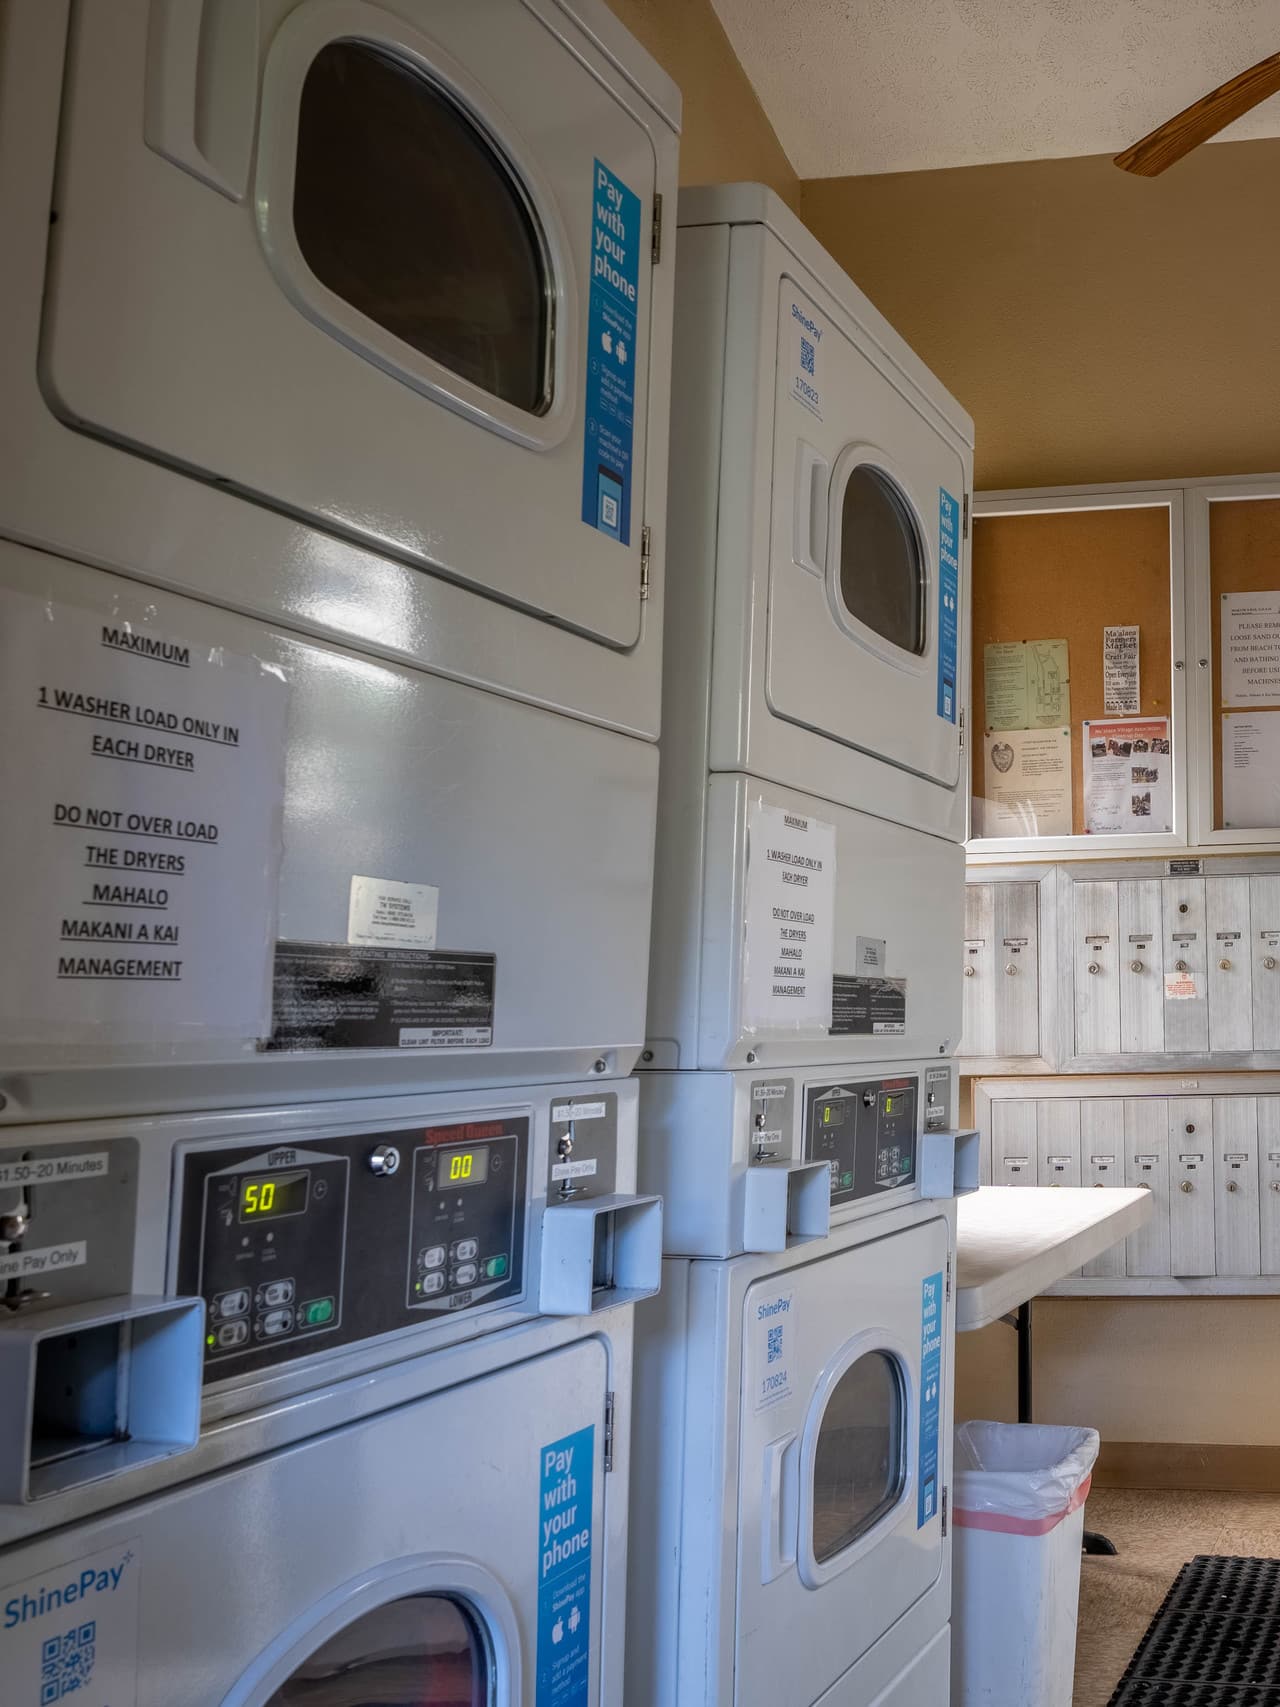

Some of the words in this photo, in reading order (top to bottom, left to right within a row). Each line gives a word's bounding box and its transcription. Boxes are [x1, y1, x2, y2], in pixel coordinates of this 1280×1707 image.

[598, 167, 623, 211] Pay
[597, 202, 625, 241] with
[595, 226, 625, 265] your
[594, 254, 635, 302] phone
[941, 492, 952, 516] Pay
[101, 626, 190, 667] MAXIMUM
[38, 686, 48, 705] 1
[53, 689, 130, 721] WASHER
[136, 705, 178, 730] LOAD
[182, 717, 220, 738] ONLY
[223, 726, 240, 744] IN
[91, 735, 138, 758] EACH
[143, 744, 194, 769] DRYER
[53, 804, 81, 824] DO
[85, 807, 123, 829] NOT
[127, 813, 172, 835] OVER
[176, 820, 218, 841] LOAD
[784, 815, 808, 831] MAXIMUM
[85, 846, 119, 865] THE
[123, 850, 185, 873] DRYERS
[771, 849, 791, 862] WASHER
[792, 854, 804, 866] LOAD
[806, 857, 816, 868] ONLY
[817, 861, 822, 869] IN
[782, 871, 792, 882] EACH
[793, 872, 808, 885] DRYER
[92, 884, 168, 906] MAHALO
[772, 907, 780, 917] DO
[780, 908, 789, 919] NOT
[790, 910, 802, 921] OVER
[803, 912, 815, 923] LOAD
[61, 919, 133, 940] MAKANI
[137, 924, 149, 941] A
[154, 925, 179, 942] KAI
[780, 927, 788, 938] THE
[789, 929, 806, 940] DRYERS
[781, 947, 802, 958] MAHALO
[57, 957, 182, 978] MANAGEMENT
[774, 965, 793, 976] MAKANI
[797, 967, 805, 976] KAI
[772, 985, 806, 996] MANAGEMENT
[425, 1125, 464, 1146] Speed
[466, 1122, 504, 1139] Queen
[56, 1159, 104, 1175] Minutes
[267, 1150, 297, 1167] UPPER
[449, 1155, 472, 1180] 00
[244, 1183, 275, 1213] 50
[23, 1255, 47, 1271] Pay
[50, 1249, 79, 1265] Only
[449, 1291, 473, 1308] LOWER
[923, 1283, 935, 1300] Pay
[757, 1298, 791, 1321] ShinePay
[923, 1300, 936, 1319] with
[923, 1320, 936, 1341] your
[923, 1335, 940, 1360] phone
[762, 1371, 788, 1395] 170824
[544, 1447, 574, 1477] Pay
[544, 1477, 577, 1511] with
[543, 1504, 578, 1547] your
[543, 1528, 589, 1578] phone
[4, 1563, 124, 1629] ShinePay
[552, 1592, 575, 1613] ShinePay
